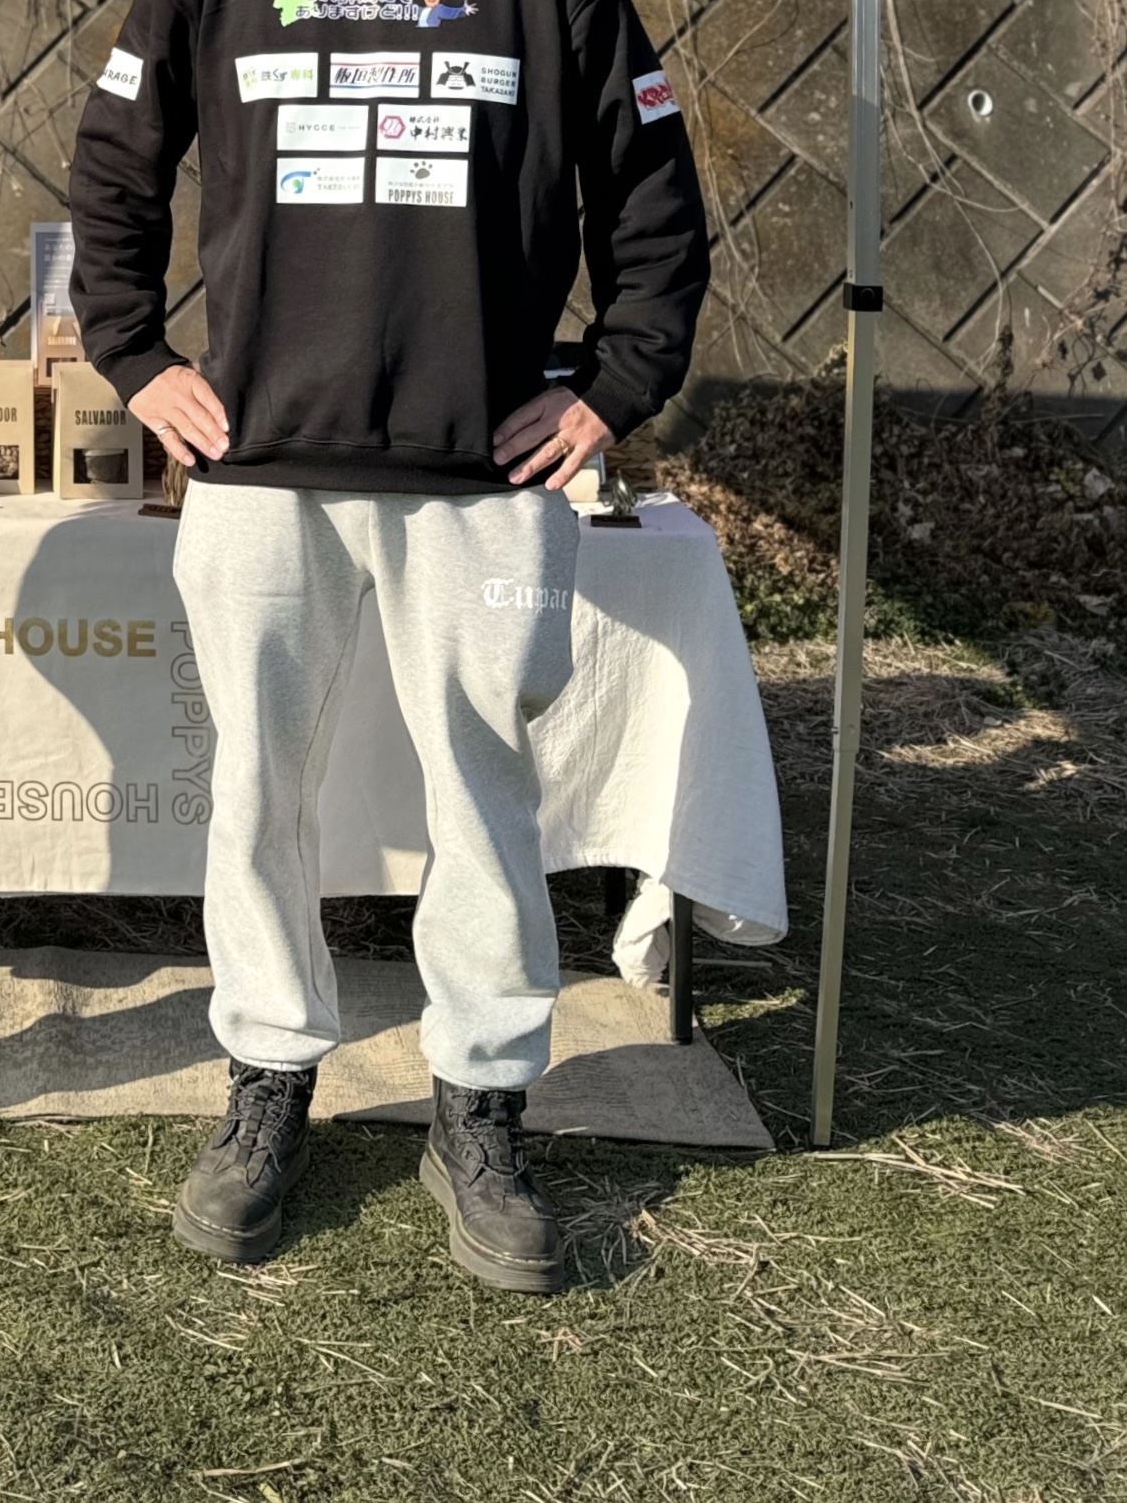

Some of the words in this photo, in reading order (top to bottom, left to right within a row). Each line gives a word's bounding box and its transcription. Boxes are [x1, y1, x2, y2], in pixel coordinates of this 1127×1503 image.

[481, 67, 517, 78] SHOGUN
[481, 77, 516, 88] BURGER
[481, 86, 515, 97] TAKASAKI
[388, 189, 422, 203] POPPYS
[425, 191, 454, 204] HOUSE
[74, 409, 127, 426] SALVADOR
